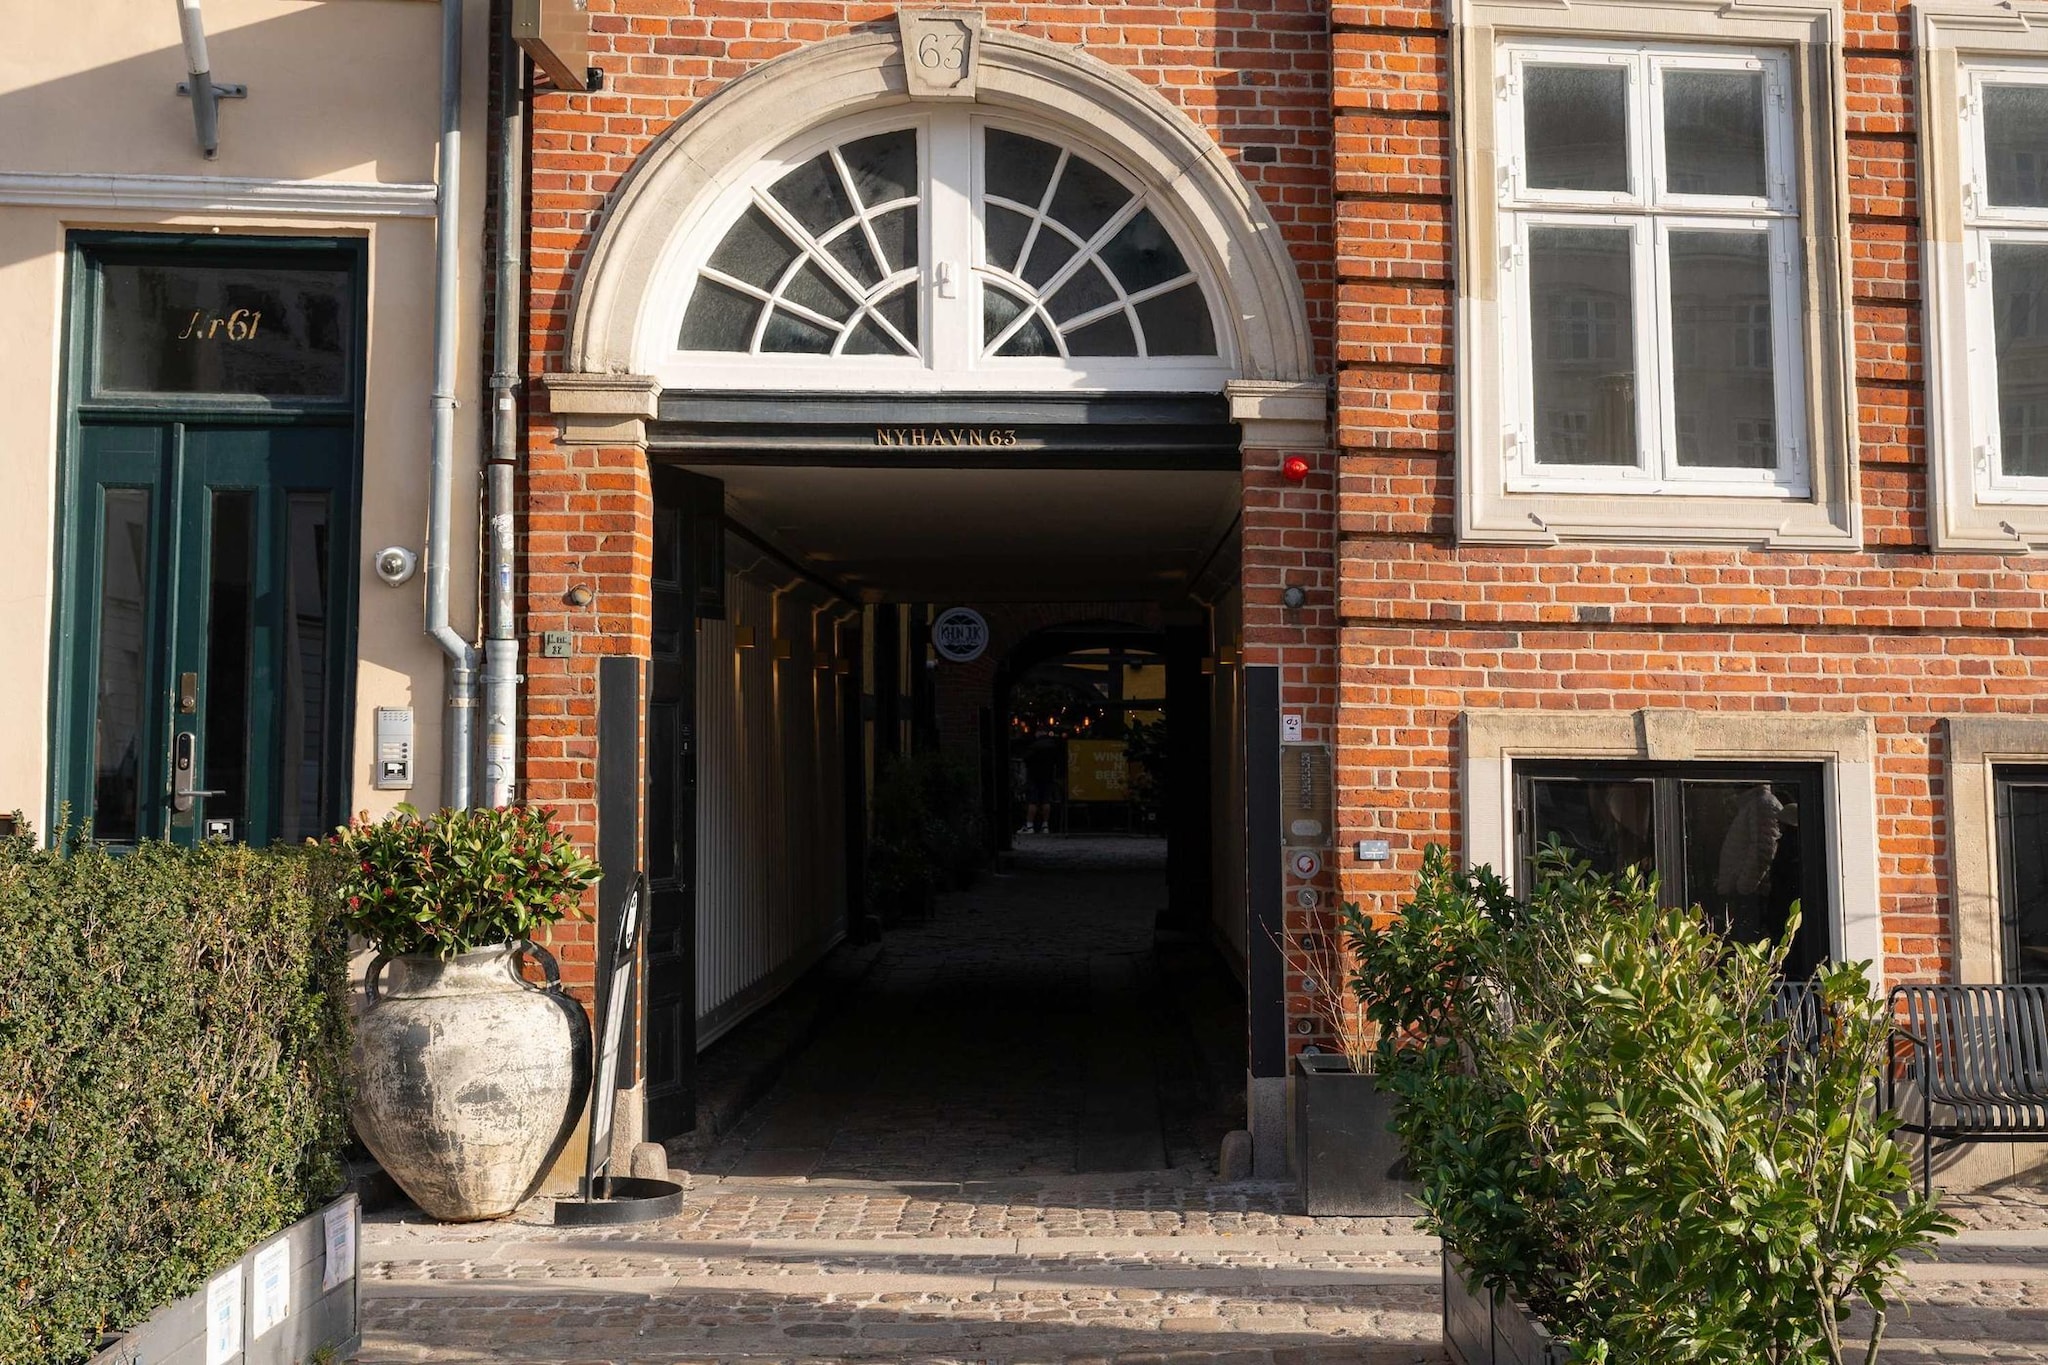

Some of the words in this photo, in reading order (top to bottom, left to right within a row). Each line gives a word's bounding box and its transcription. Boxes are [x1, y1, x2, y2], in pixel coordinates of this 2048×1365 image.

[918, 33, 963, 70] 63
[876, 428, 983, 446] NYHAVN
[989, 429, 1017, 446] 63
